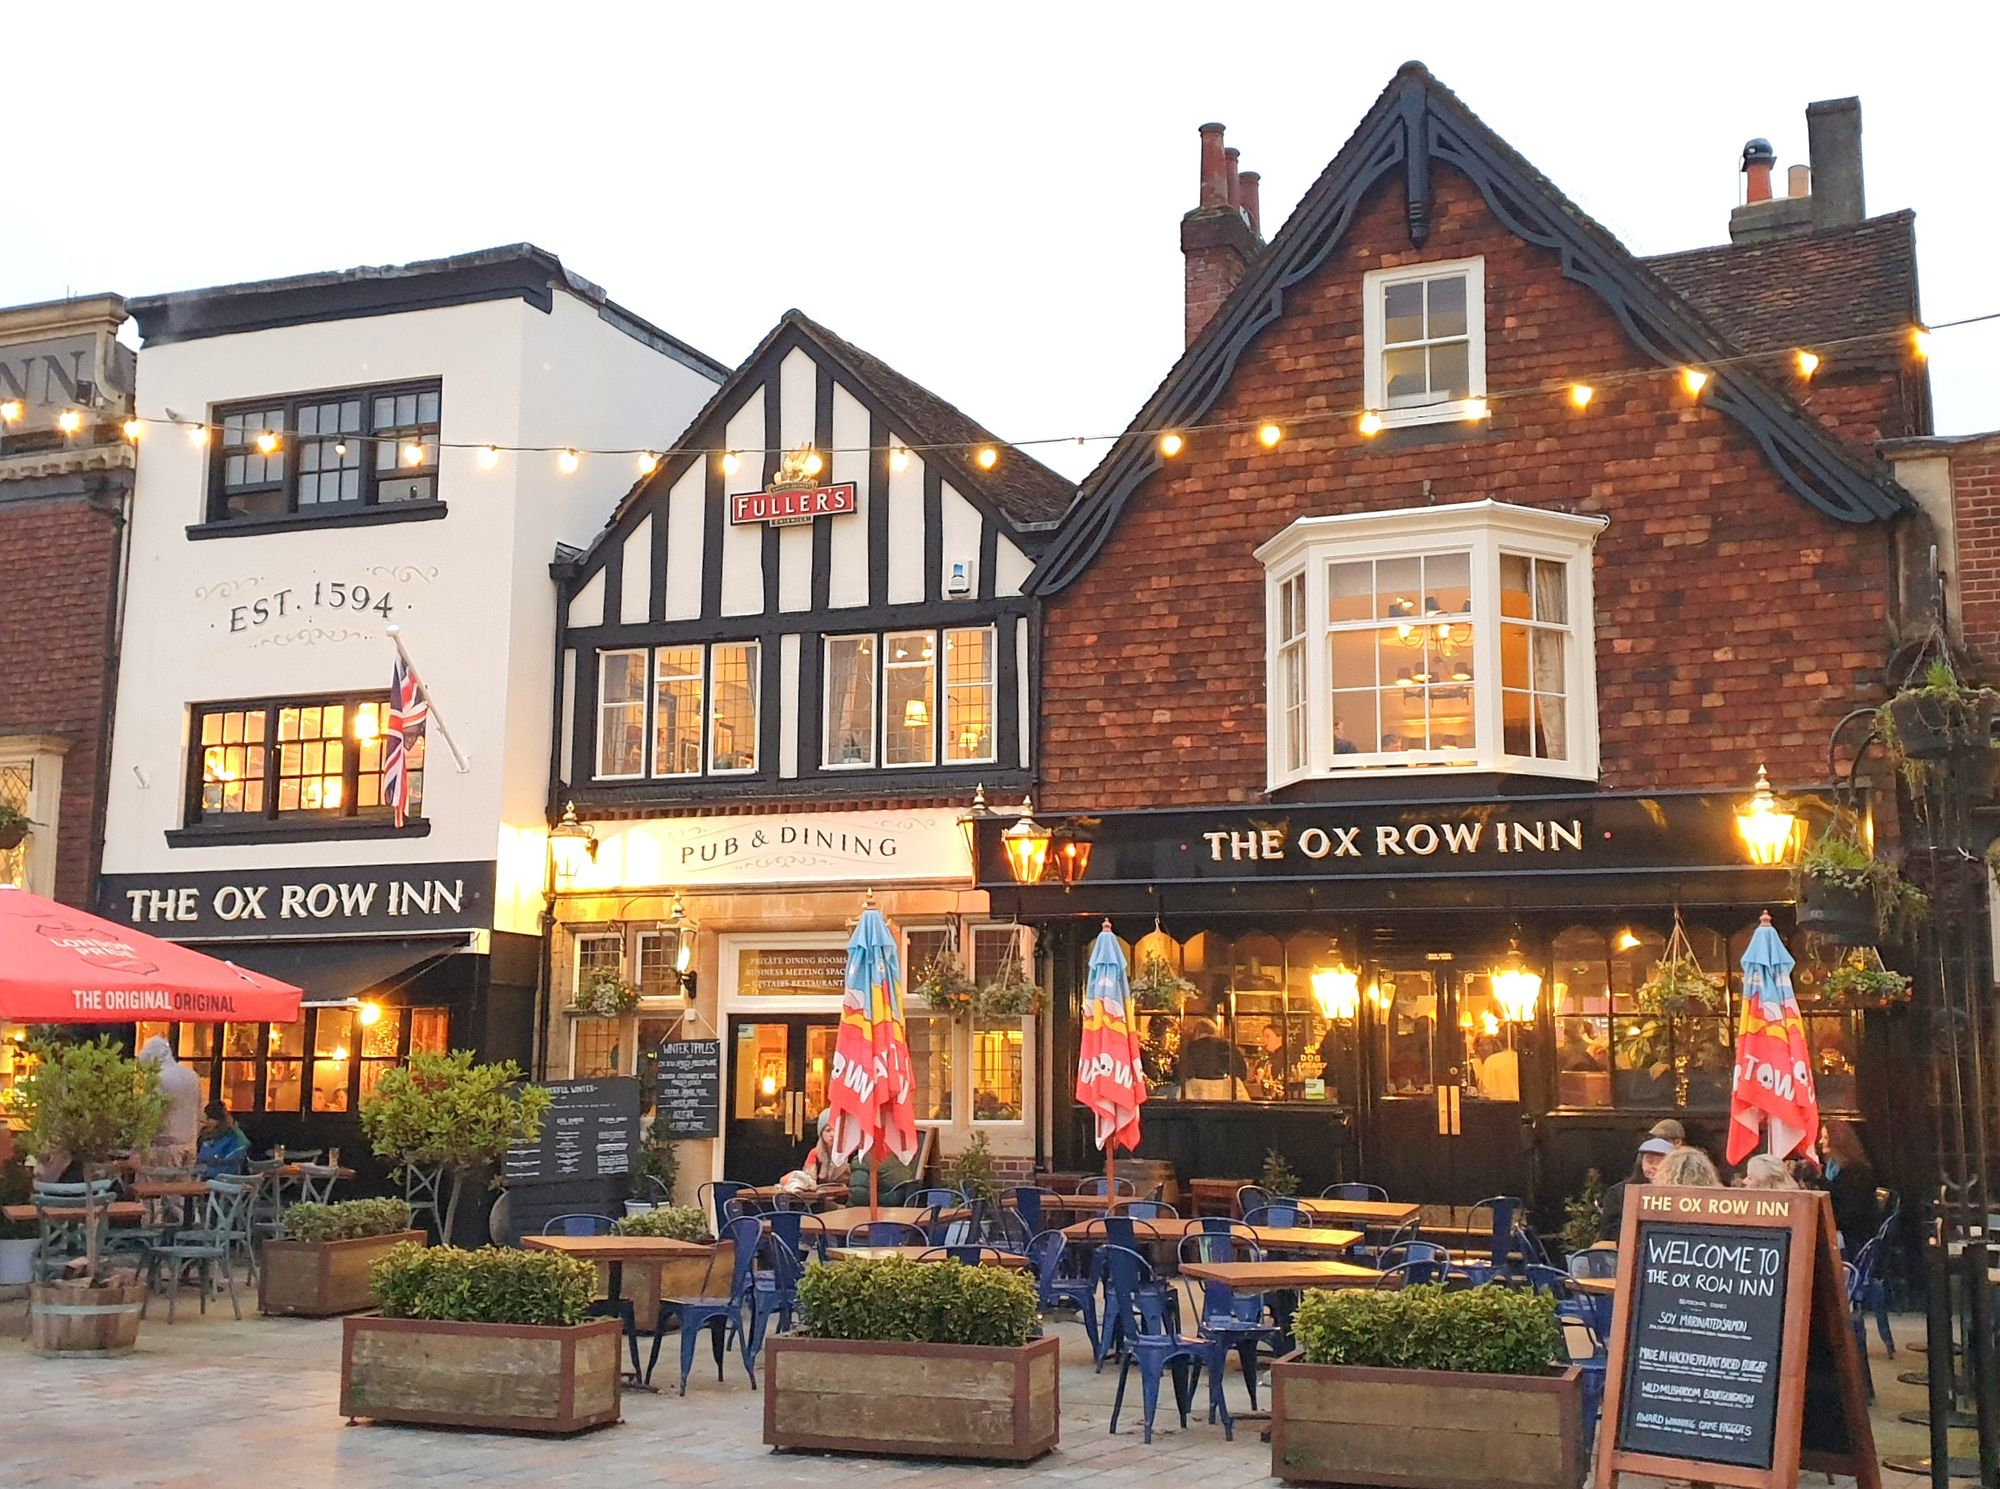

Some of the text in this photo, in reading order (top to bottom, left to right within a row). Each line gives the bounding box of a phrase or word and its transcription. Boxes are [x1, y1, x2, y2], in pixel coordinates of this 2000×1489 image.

[738, 488, 845, 518] FULLER'S
[229, 581, 393, 633] EST. 1594
[681, 826, 897, 864] PUB & DINING
[1203, 819, 1583, 861] THE OX ROW INN
[126, 879, 464, 922] THE OX ROW INN
[746, 967, 846, 976] BUSINESS MEETING SPAC
[750, 956, 847, 965] PRIVATE DINING ROOMS
[791, 979, 845, 987] RESTAURANT
[72, 989, 236, 1013] THE ORIGINAL ORIGINAL
[1641, 1195, 1789, 1217] THE OX ROW INN
[1648, 1238, 1780, 1276] WELCOME TO
[1646, 1269, 1775, 1297] THE OX ROW INN
[1658, 1311, 1748, 1332] SOY MARINATED SALMON
[1639, 1347, 1659, 1361] MADE
[1659, 1350, 1668, 1362] IN
[1741, 1359, 1768, 1374] BURGER
[1641, 1381, 1660, 1393] WILD
[1660, 1384, 1701, 1398] MUSHROOM
[1636, 1412, 1664, 1425] AWARD
[1698, 1420, 1718, 1431] GAME
